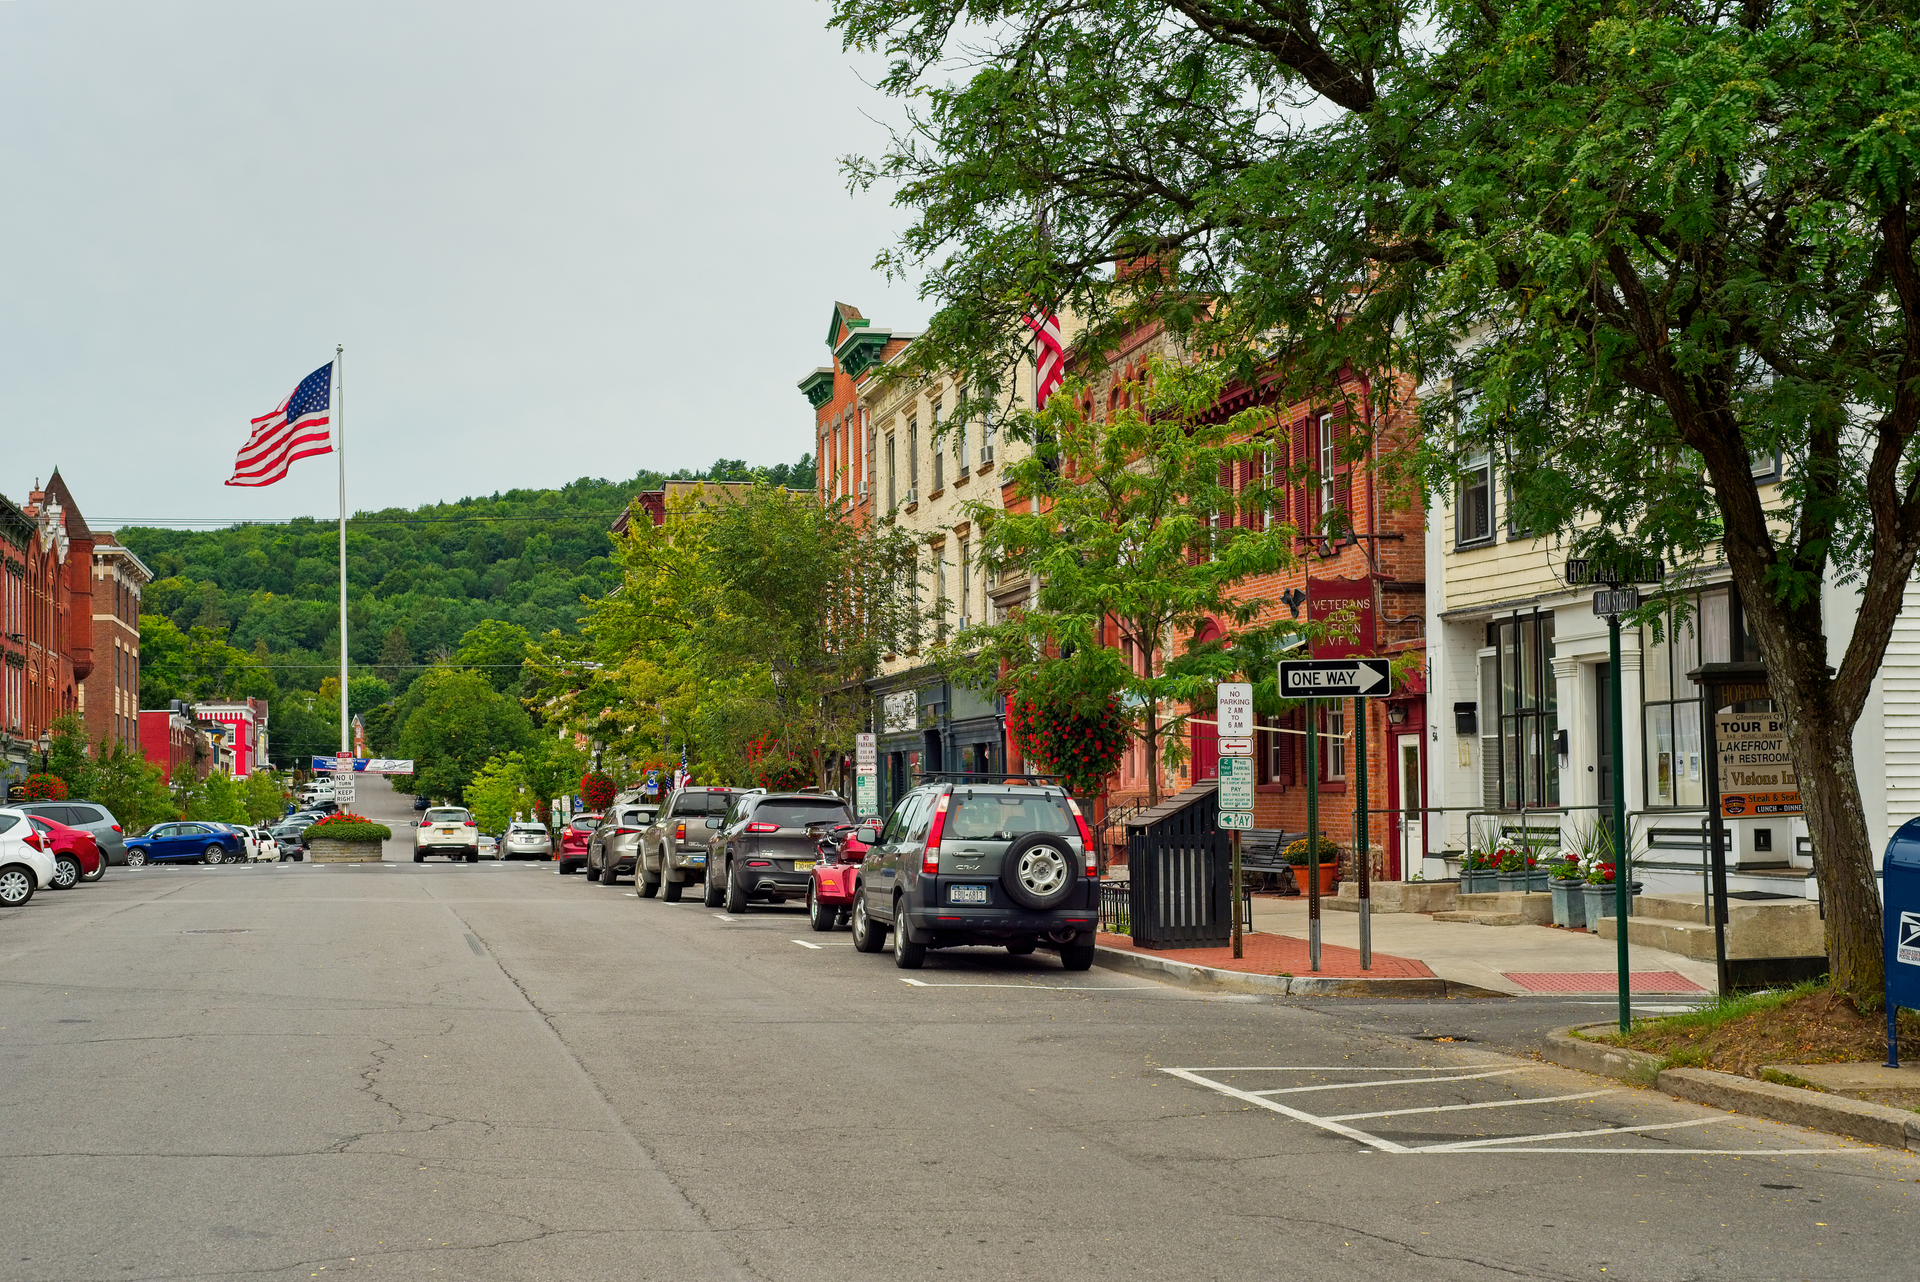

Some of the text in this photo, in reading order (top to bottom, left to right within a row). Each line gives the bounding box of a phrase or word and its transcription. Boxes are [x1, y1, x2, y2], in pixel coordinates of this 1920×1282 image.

[1634, 561, 1662, 581] LAE
[1313, 598, 1370, 610] VETERANS
[1597, 590, 1633, 613] MAIN STREET
[1292, 671, 1356, 686] ONE WAY
[1229, 690, 1240, 698] NO
[1220, 698, 1250, 706] PARKING
[1736, 714, 1772, 722] Glimmerglass
[1721, 722, 1761, 732] TOUR
[1720, 740, 1782, 752] LAKEFRONT
[1739, 752, 1792, 763] RESTROOM
[1731, 770, 1797, 786] Visions In
[1748, 794, 1770, 802] Steak
[1773, 794, 1778, 802] &
[1234, 815, 1250, 826] PAY
